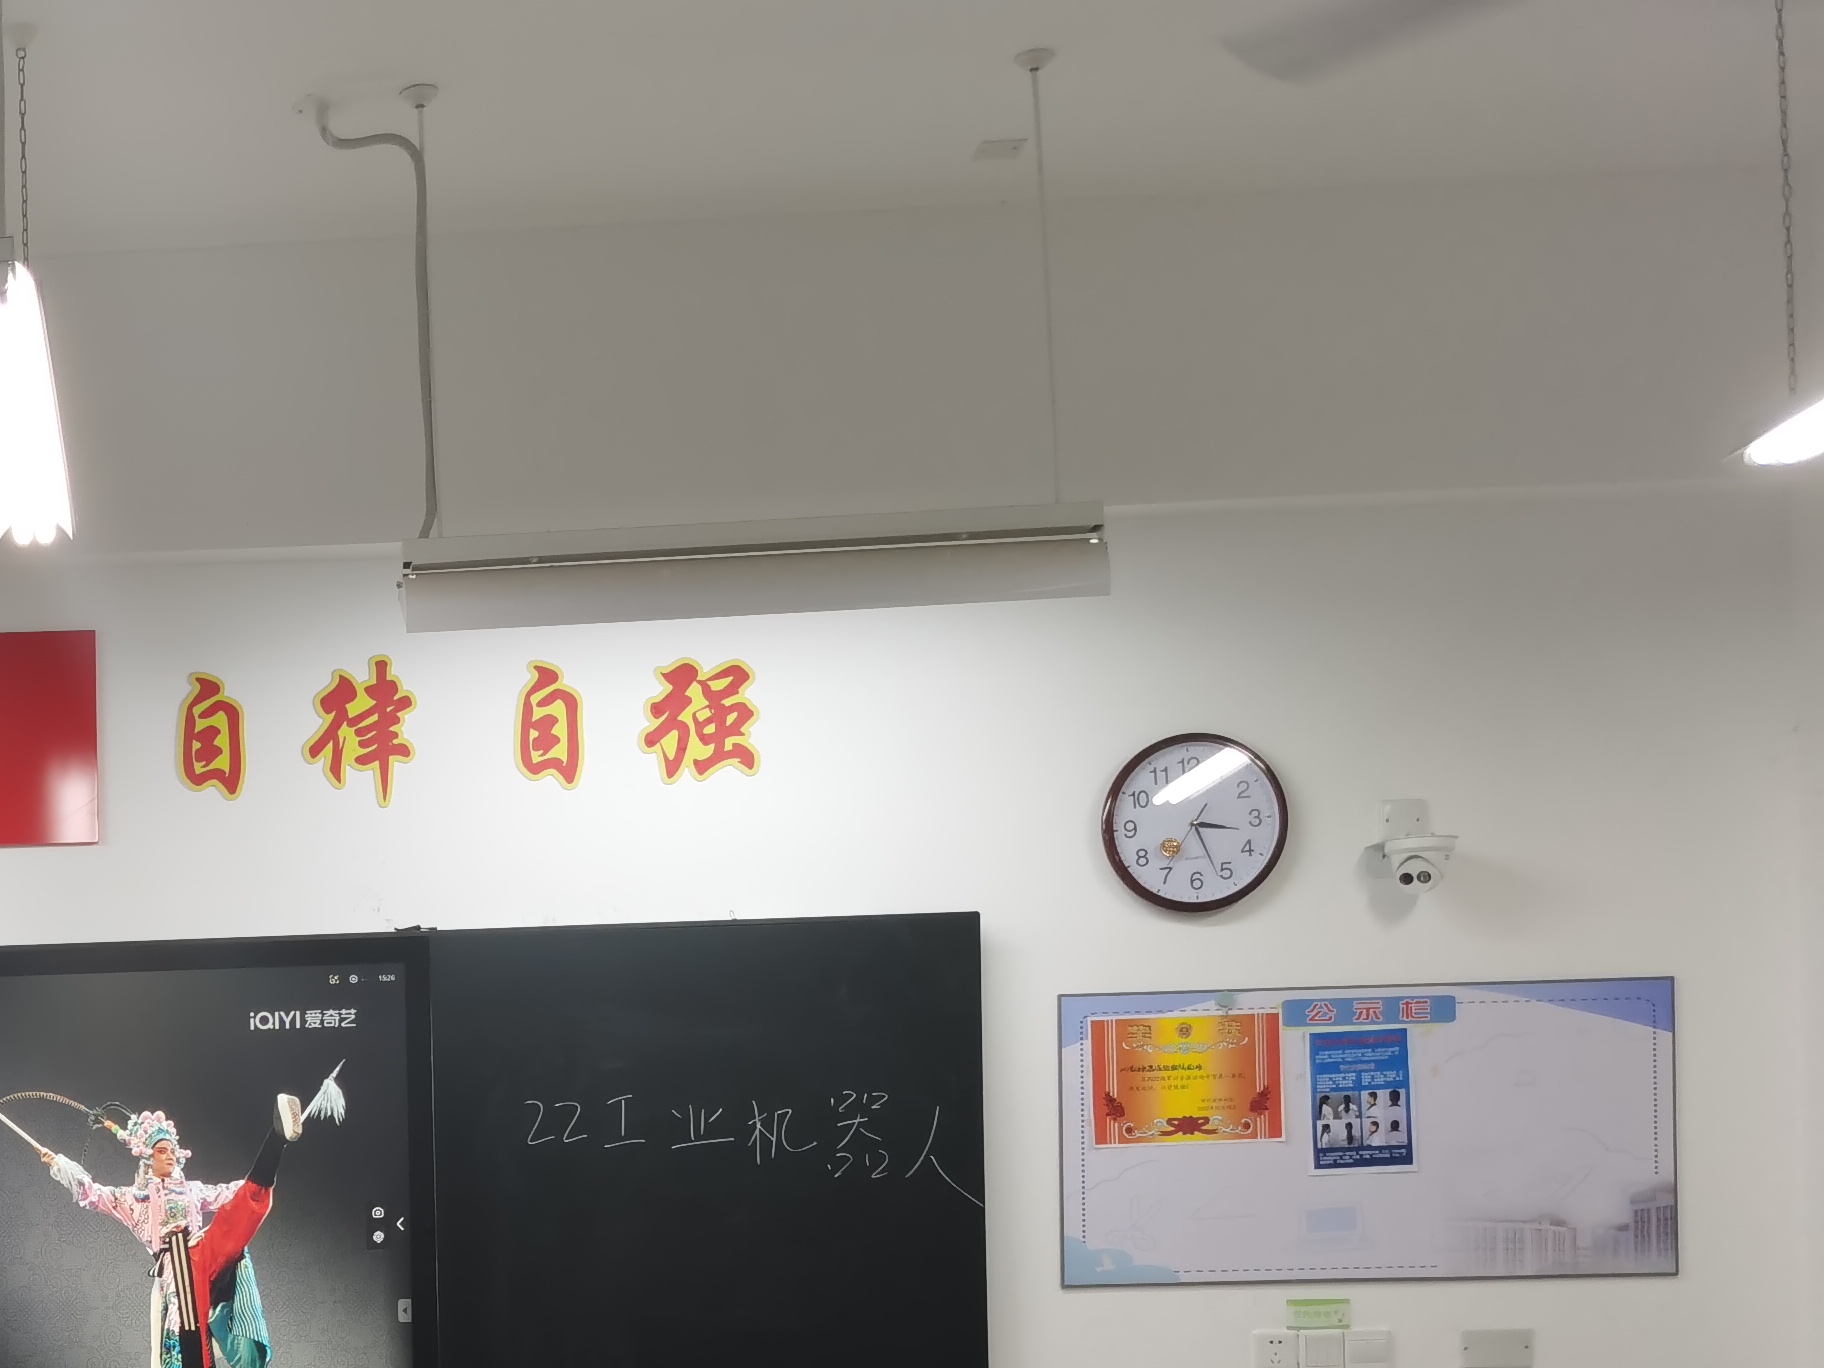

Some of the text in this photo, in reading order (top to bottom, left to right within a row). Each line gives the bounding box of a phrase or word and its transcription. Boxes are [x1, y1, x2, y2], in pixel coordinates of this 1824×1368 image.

[1149, 766, 1169, 785] 11
[1128, 790, 1150, 809] 10
[1237, 781, 1251, 799] 2
[1248, 808, 1262, 827] 3
[1123, 820, 1137, 838] 9
[1240, 838, 1255, 857] 4
[1135, 849, 1150, 867] 8
[1159, 866, 1173, 885] 7
[1219, 861, 1233, 880] 5
[1190, 871, 1204, 890] 6
[304, 1008, 357, 1028] 爱奇艺
[1305, 999, 1431, 1024] 公示栏
